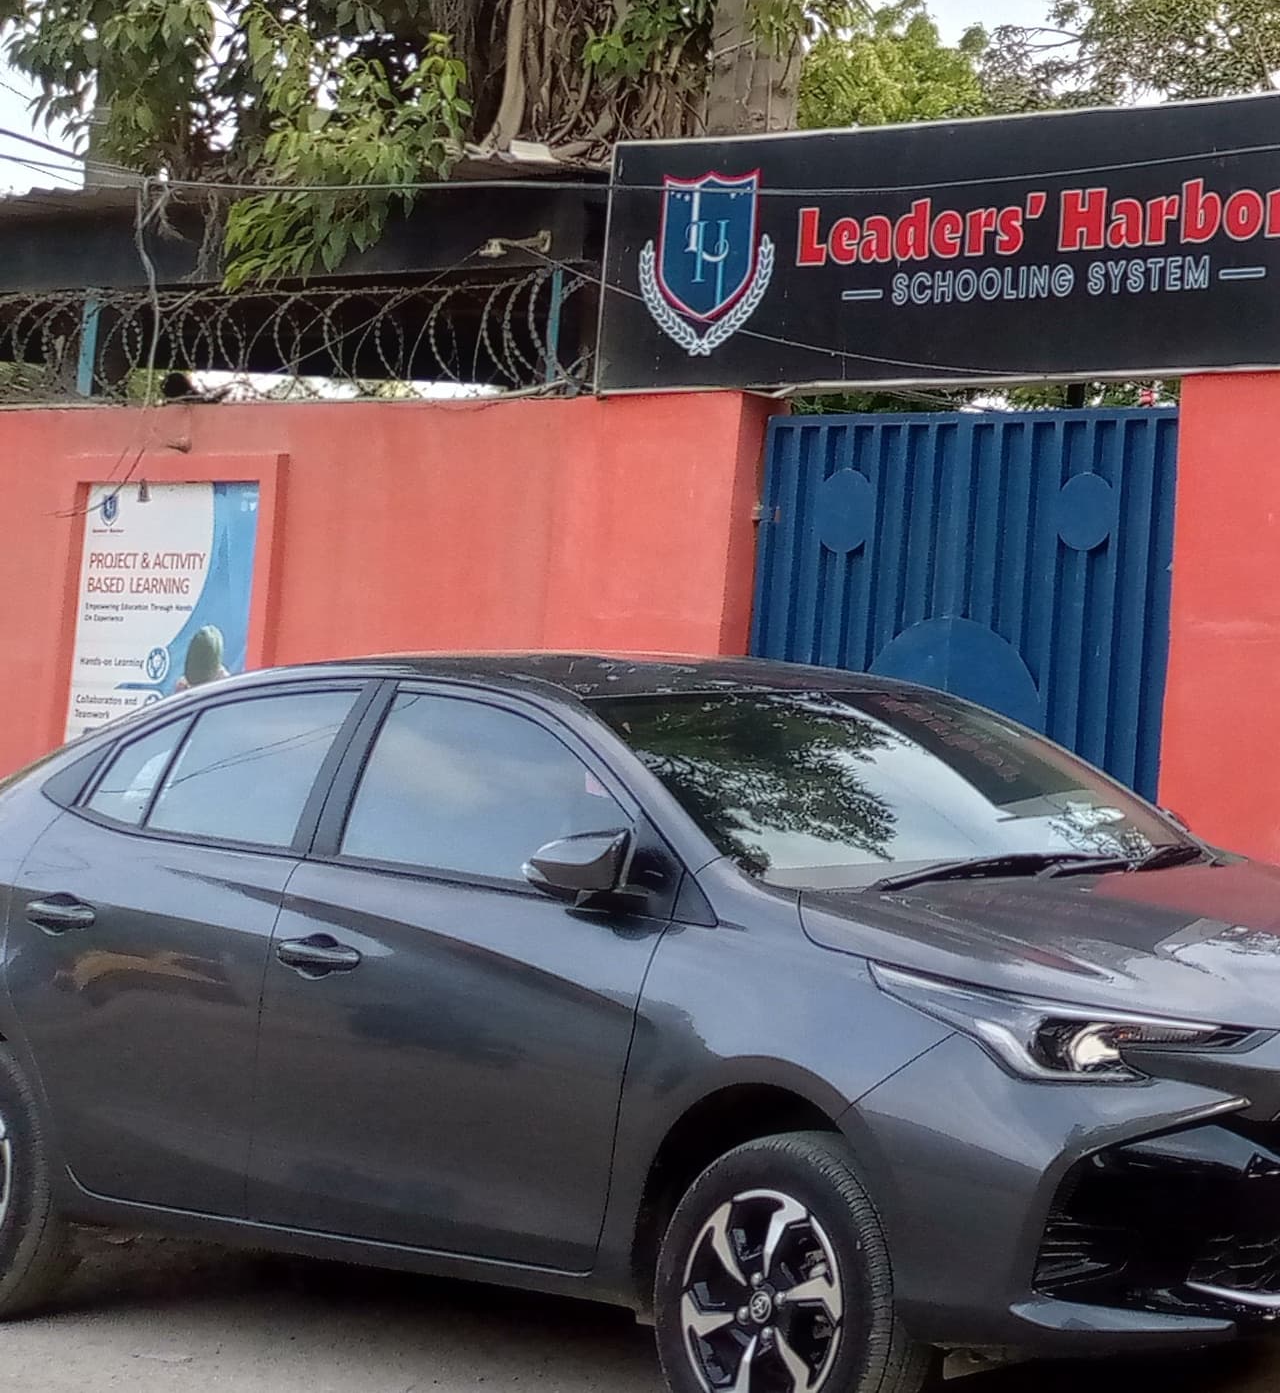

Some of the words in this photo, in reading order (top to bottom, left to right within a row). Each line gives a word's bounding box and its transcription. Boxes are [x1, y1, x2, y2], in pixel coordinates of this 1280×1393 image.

[796, 191, 1047, 267] Leaders'
[892, 263, 1075, 305] SCHOOLING
[1087, 256, 1210, 295] SYSTEM
[89, 552, 139, 569] PROJECT
[141, 552, 152, 569] &
[152, 553, 206, 570] ACTIVITY
[87, 577, 125, 594] BASED
[130, 578, 190, 594] LEARNING
[114, 657, 145, 669] Learning
